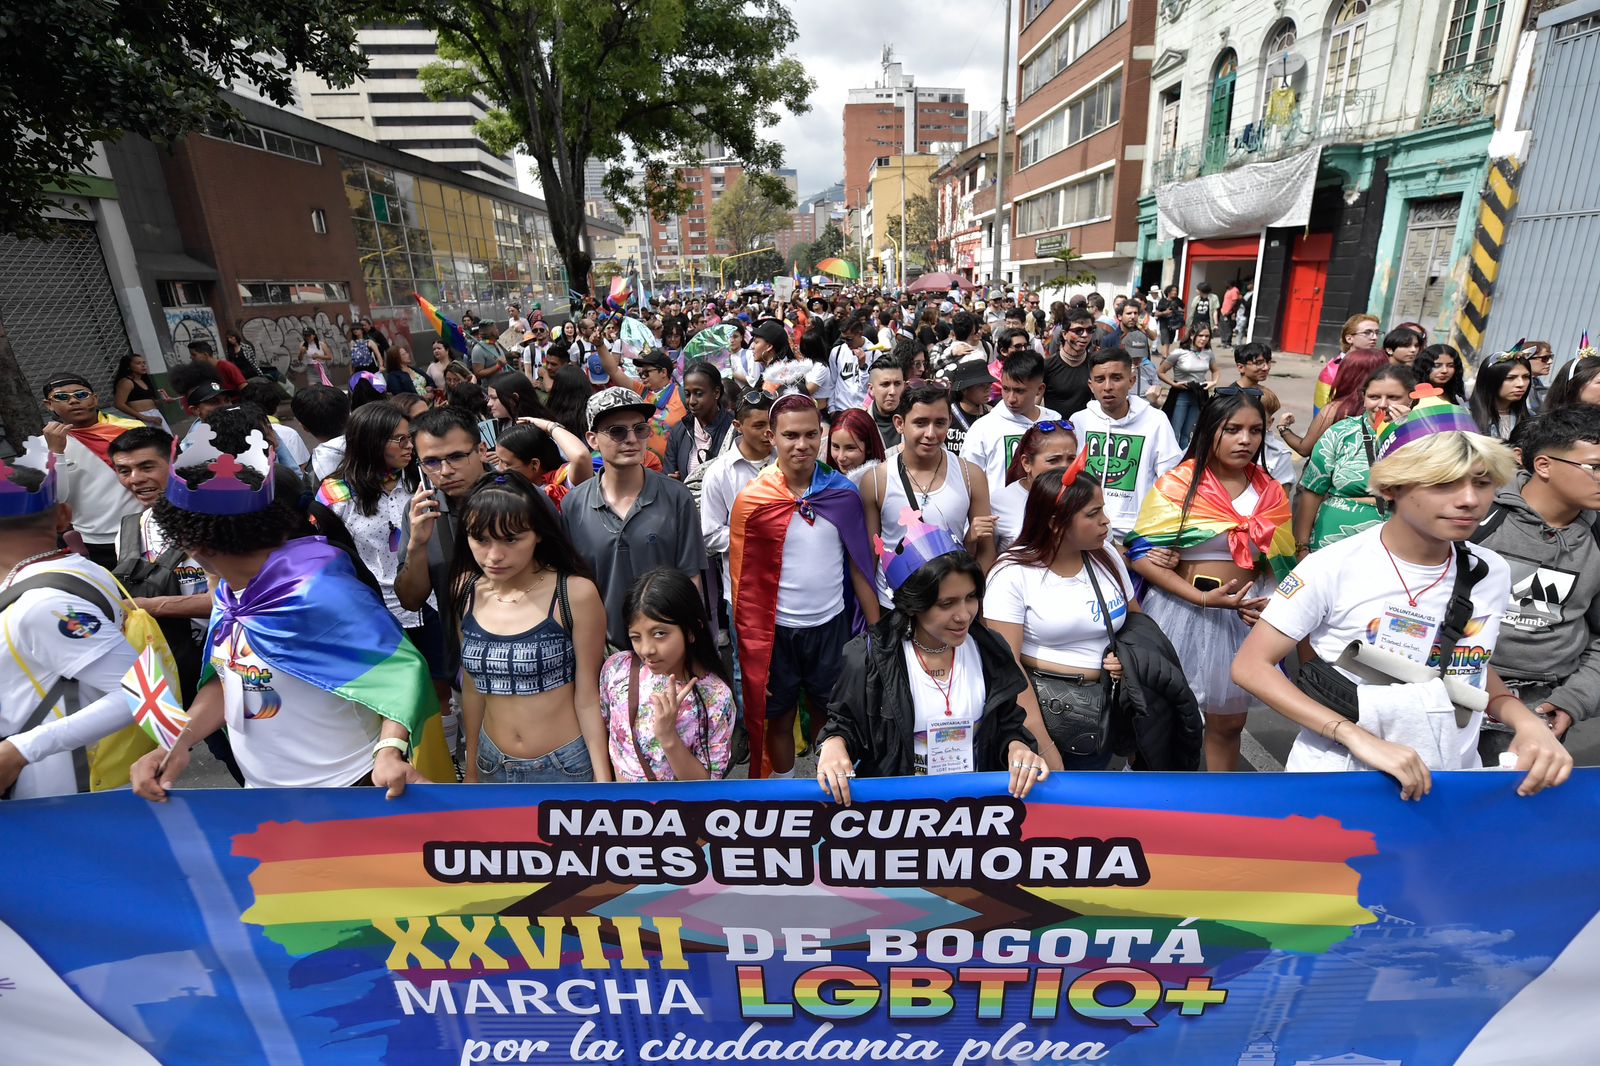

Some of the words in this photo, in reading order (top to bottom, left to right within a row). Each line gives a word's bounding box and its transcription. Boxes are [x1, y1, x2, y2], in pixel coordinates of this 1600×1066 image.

[549, 809, 687, 836] NADA
[704, 808, 814, 840] QUE
[830, 805, 1014, 839] CURAR
[721, 847, 803, 879] EN
[830, 846, 1139, 880] MEMORIA
[371, 916, 689, 969] XXVIII
[722, 927, 832, 962] DE
[866, 917, 1206, 964] BOGOTÁ
[394, 979, 704, 1015] MARCHA
[735, 964, 1229, 1028] LGBTIQ+
[460, 1038, 549, 1066] por
[569, 1020, 625, 1062] la
[952, 1022, 1109, 1066] plena
